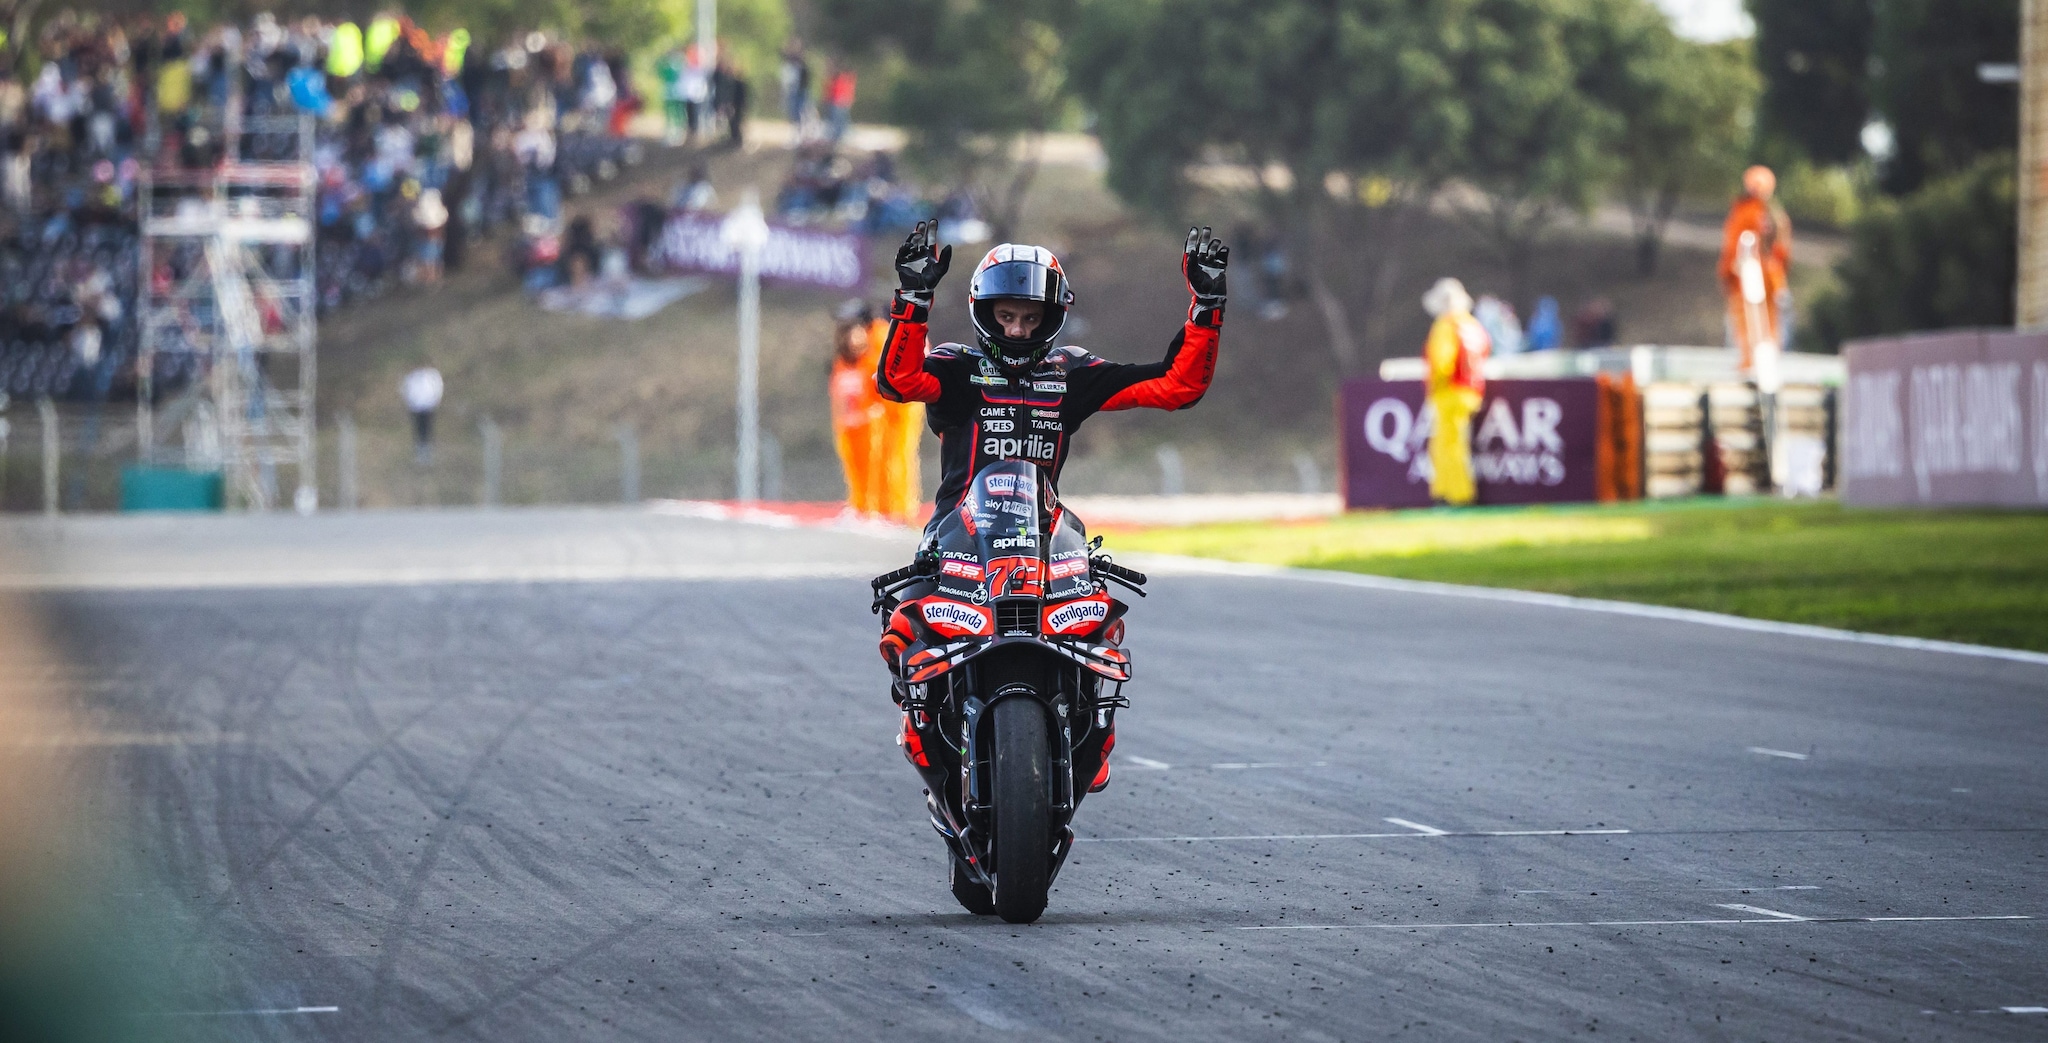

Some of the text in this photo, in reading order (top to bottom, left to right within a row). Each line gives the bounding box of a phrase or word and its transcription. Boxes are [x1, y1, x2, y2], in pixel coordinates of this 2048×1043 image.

[1002, 355, 1030, 366] aprilia
[980, 407, 1006, 417] CAME
[1031, 420, 1063, 431] TARGA
[1364, 397, 1565, 463] QAAR
[983, 434, 1055, 460] aprilia
[984, 499, 1002, 511] sky
[993, 535, 1036, 549] aprilia
[941, 551, 979, 563] TARGA
[942, 561, 983, 577] BS
[1050, 559, 1087, 576] BS
[938, 585, 972, 598] PRAGMATIC
[1046, 588, 1077, 600] PRAGMATIC
[926, 604, 982, 629] sterilgarda
[1051, 602, 1105, 628] sterilgarda
